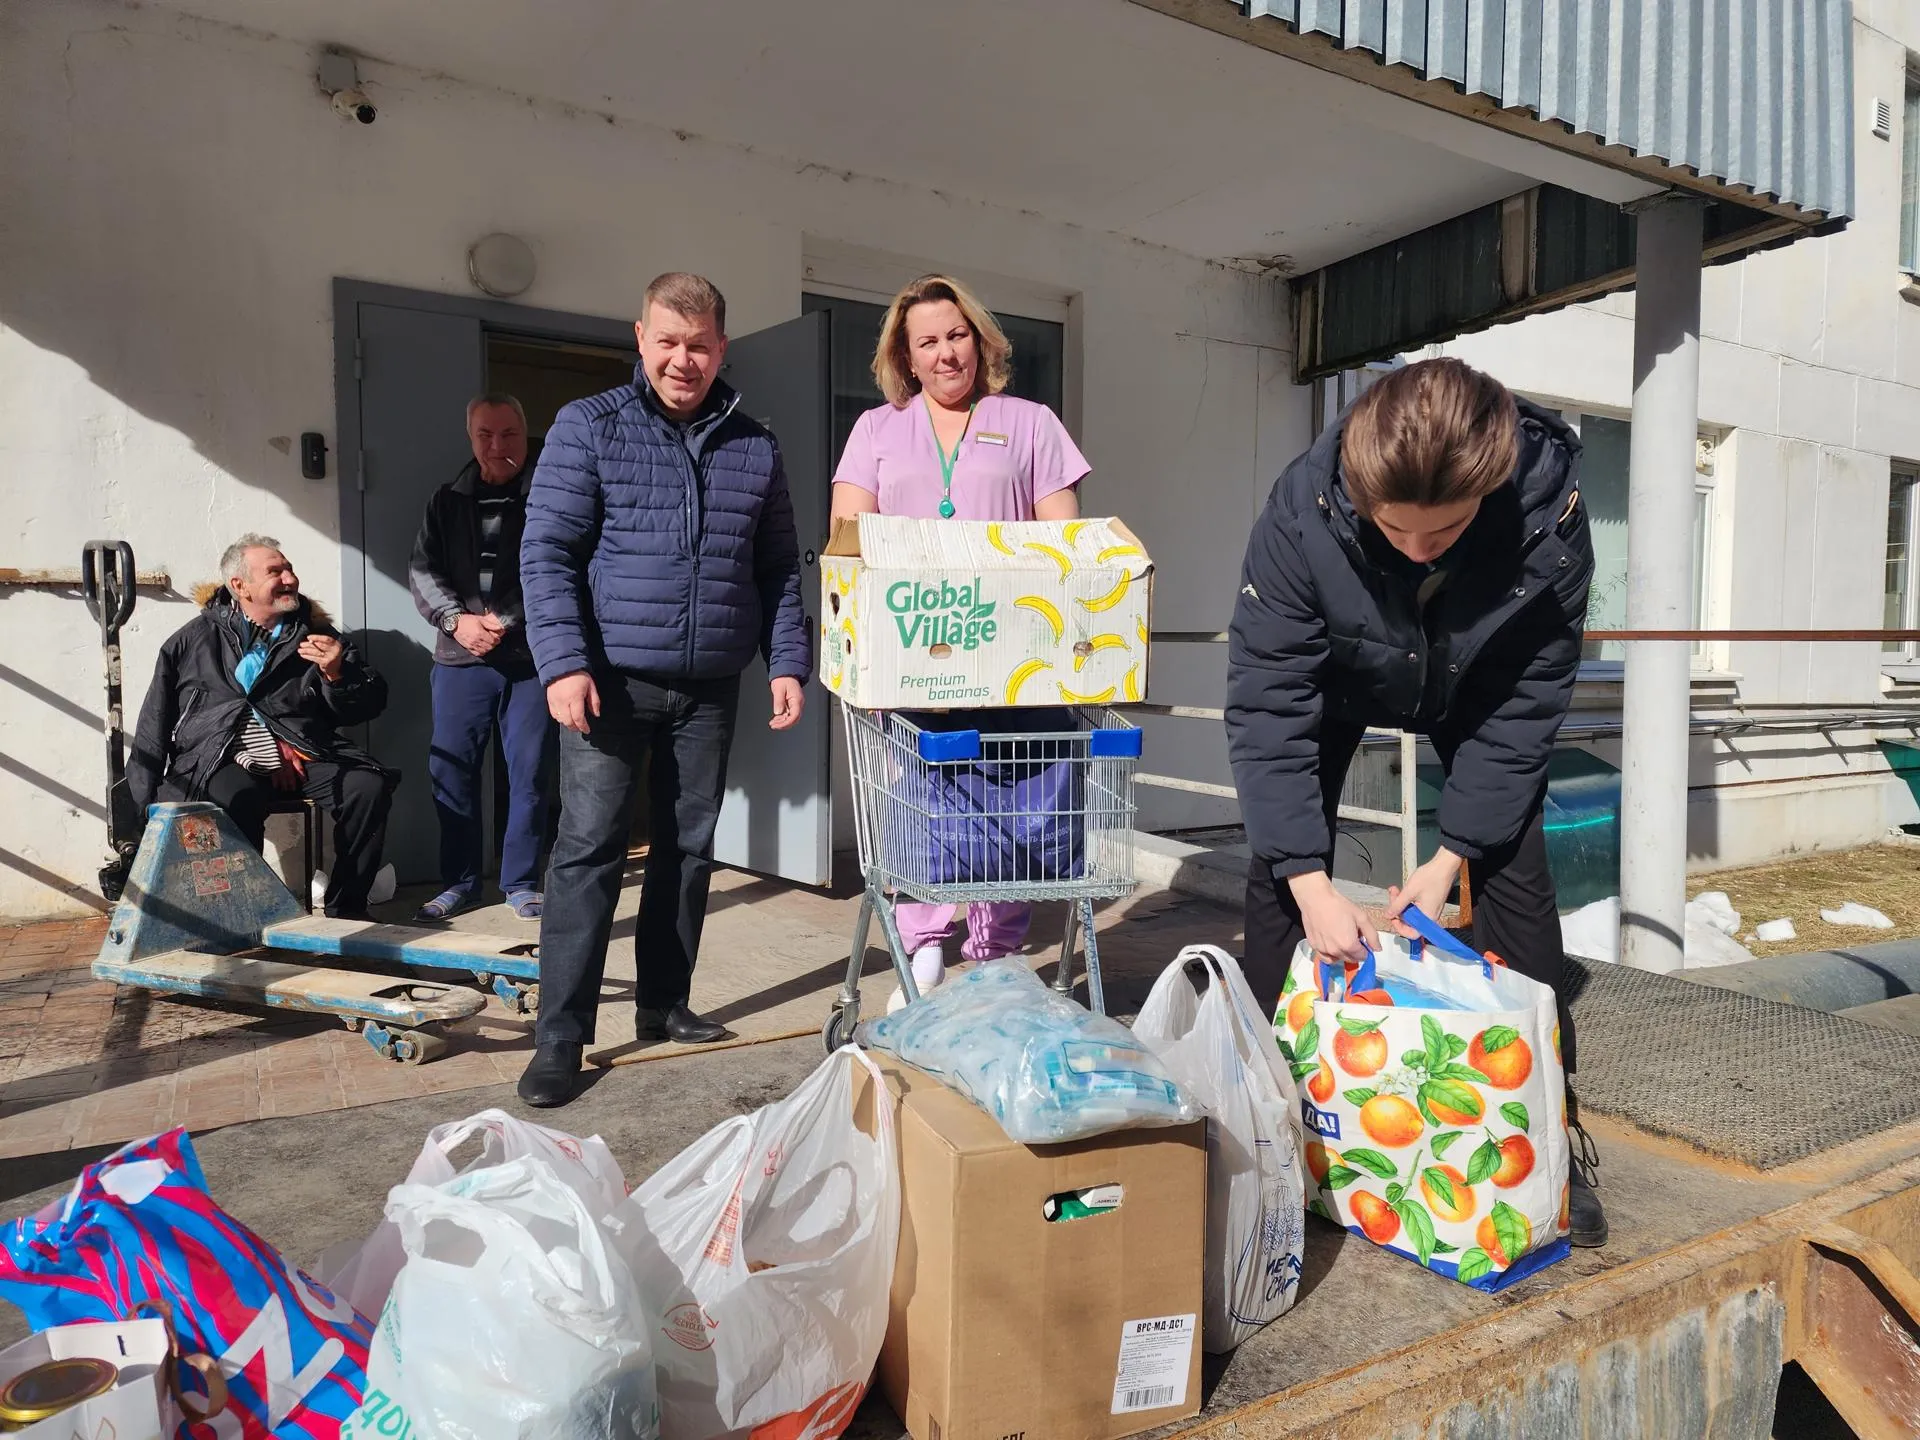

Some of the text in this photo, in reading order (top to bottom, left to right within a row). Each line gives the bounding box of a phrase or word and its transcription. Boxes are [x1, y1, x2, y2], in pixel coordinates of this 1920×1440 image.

[885, 577, 995, 614] Global
[894, 613, 997, 651] Village
[900, 673, 966, 689] Premium
[928, 686, 990, 701] bananas
[1304, 1106, 1337, 1133] ДА!
